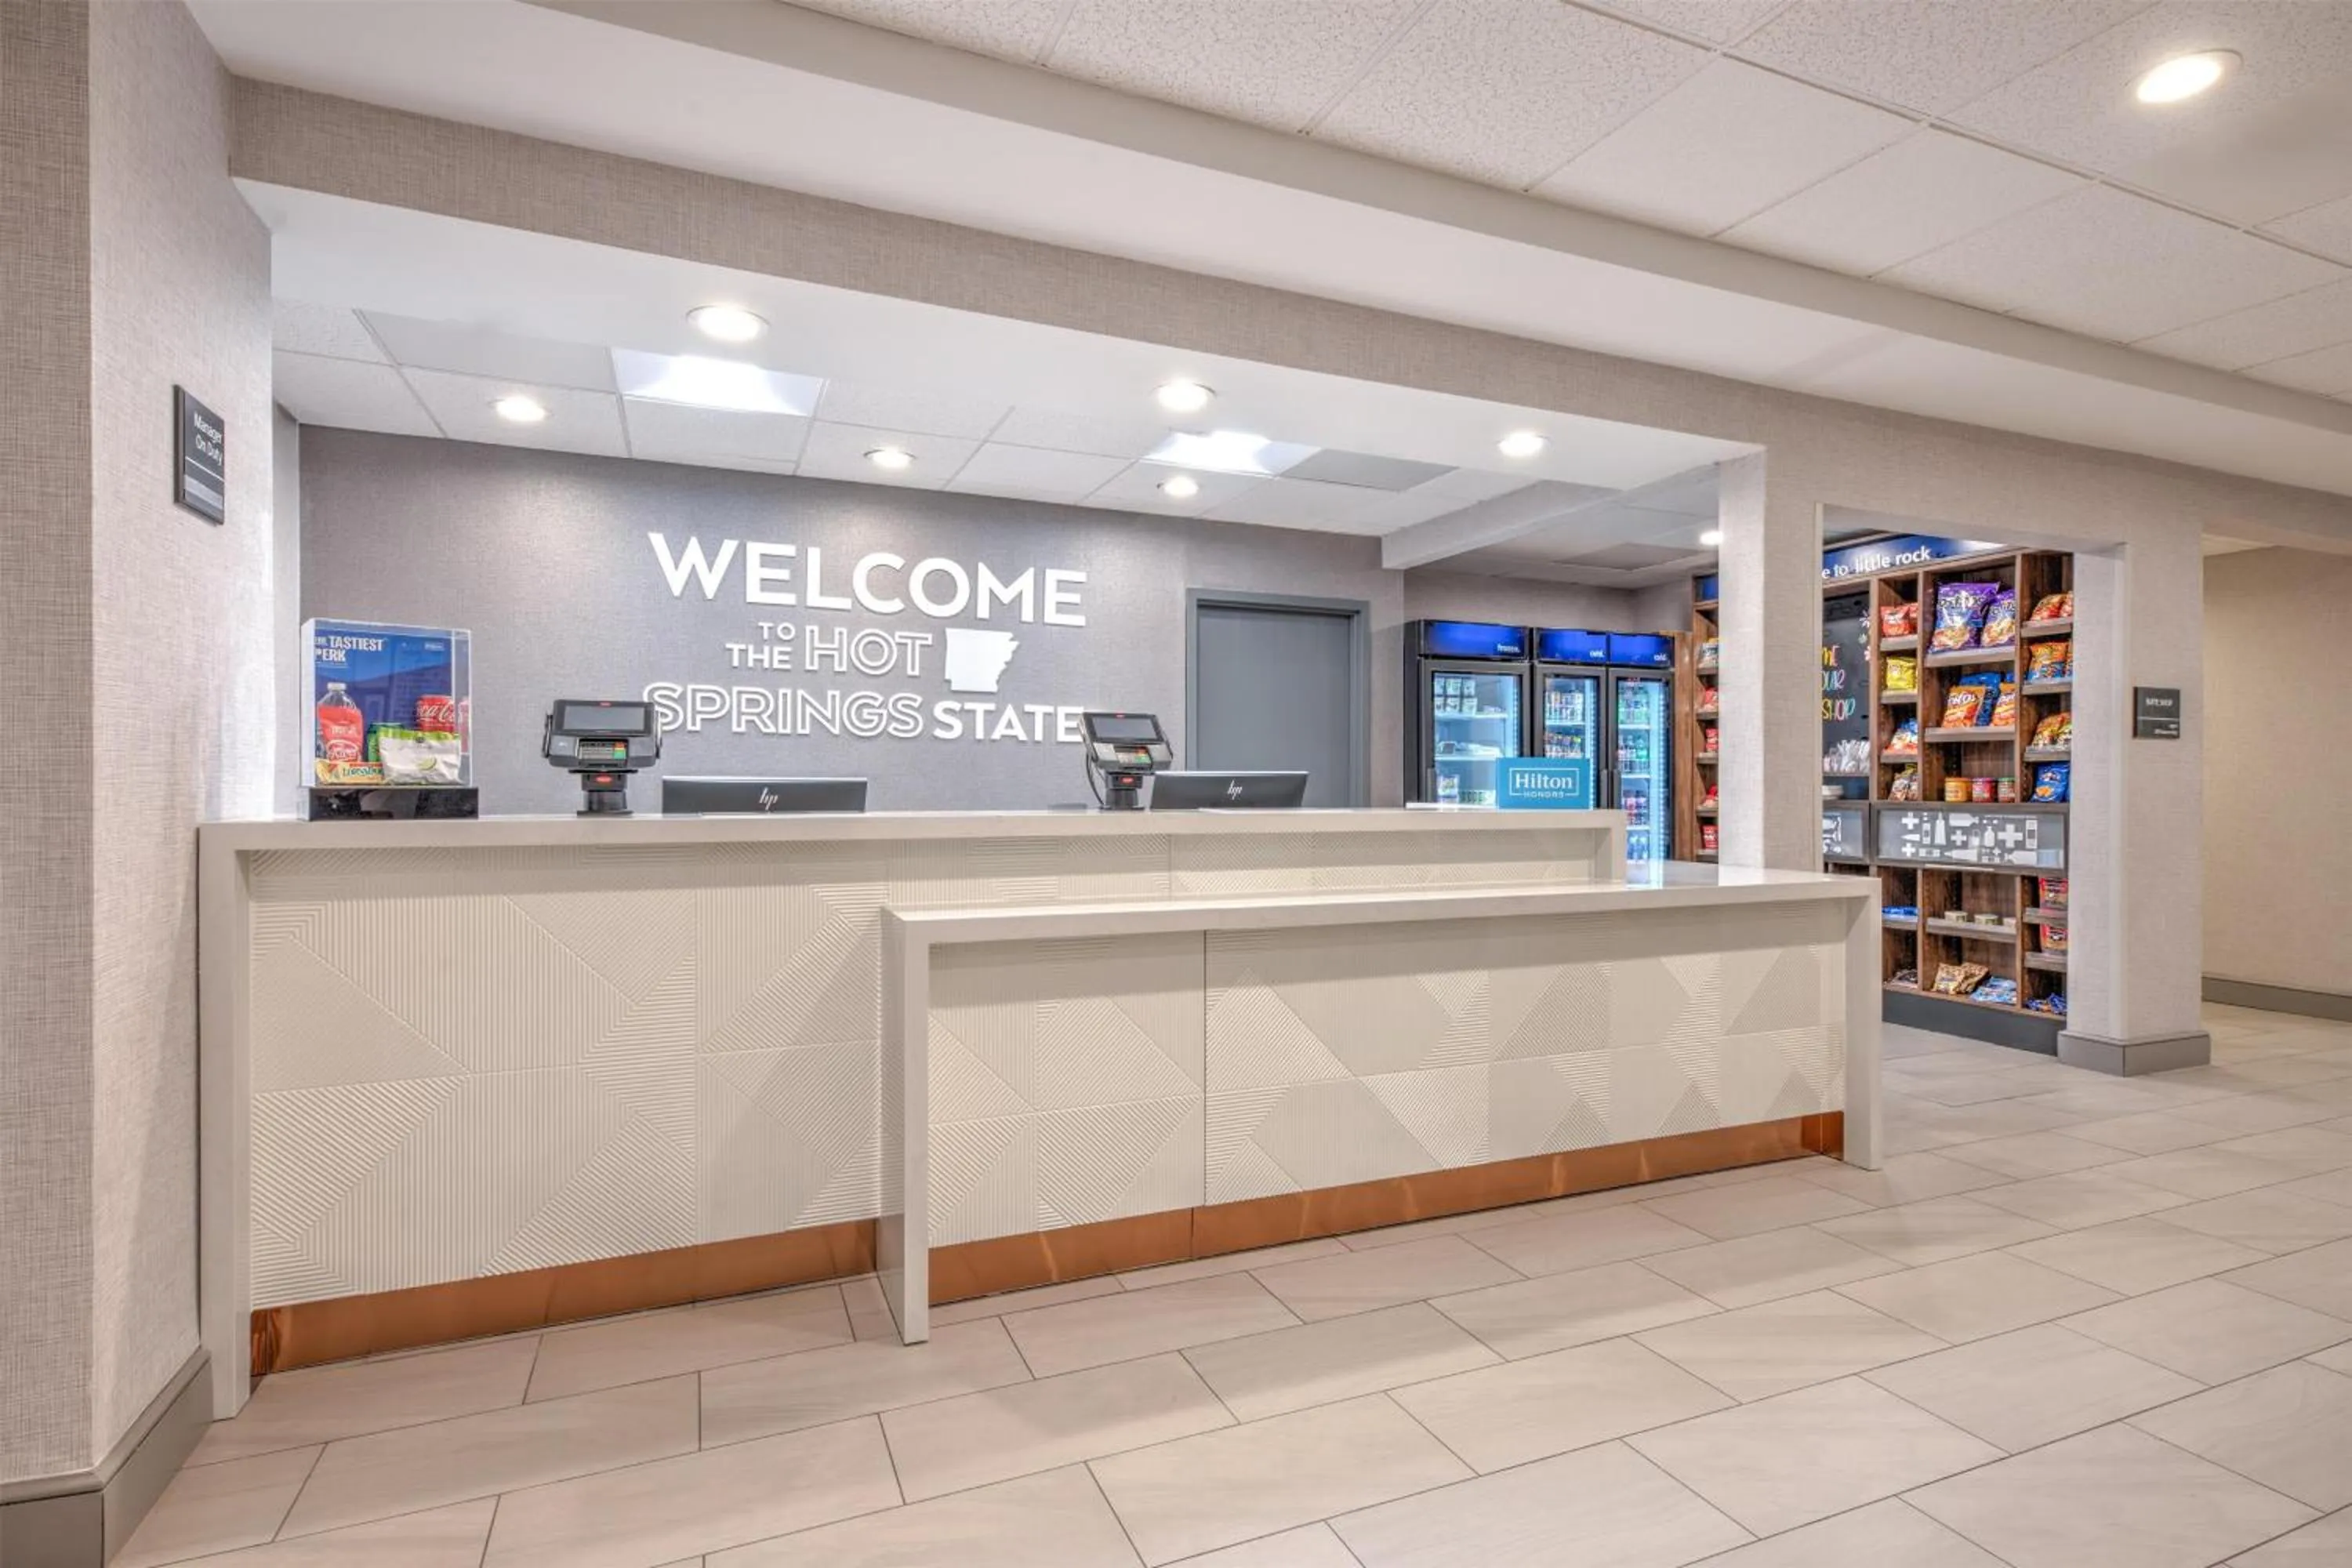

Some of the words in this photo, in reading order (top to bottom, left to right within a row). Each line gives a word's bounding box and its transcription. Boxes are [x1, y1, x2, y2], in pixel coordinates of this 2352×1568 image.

[194, 412, 222, 444] Manager
[196, 434, 205, 452] On
[208, 441, 223, 466] Duty
[1856, 554, 1891, 574] little
[1896, 545, 1933, 564] rock
[648, 532, 1087, 626] WELCOME
[328, 636, 383, 652] TASTIEST
[758, 622, 795, 640] TO
[725, 643, 792, 670] THE
[805, 626, 932, 676] HOT
[643, 682, 923, 739] SPRINGS
[933, 701, 1084, 742] STATE
[1227, 780, 1243, 800] hp
[1515, 773, 1573, 789] Hilton
[759, 786, 779, 811] hp
